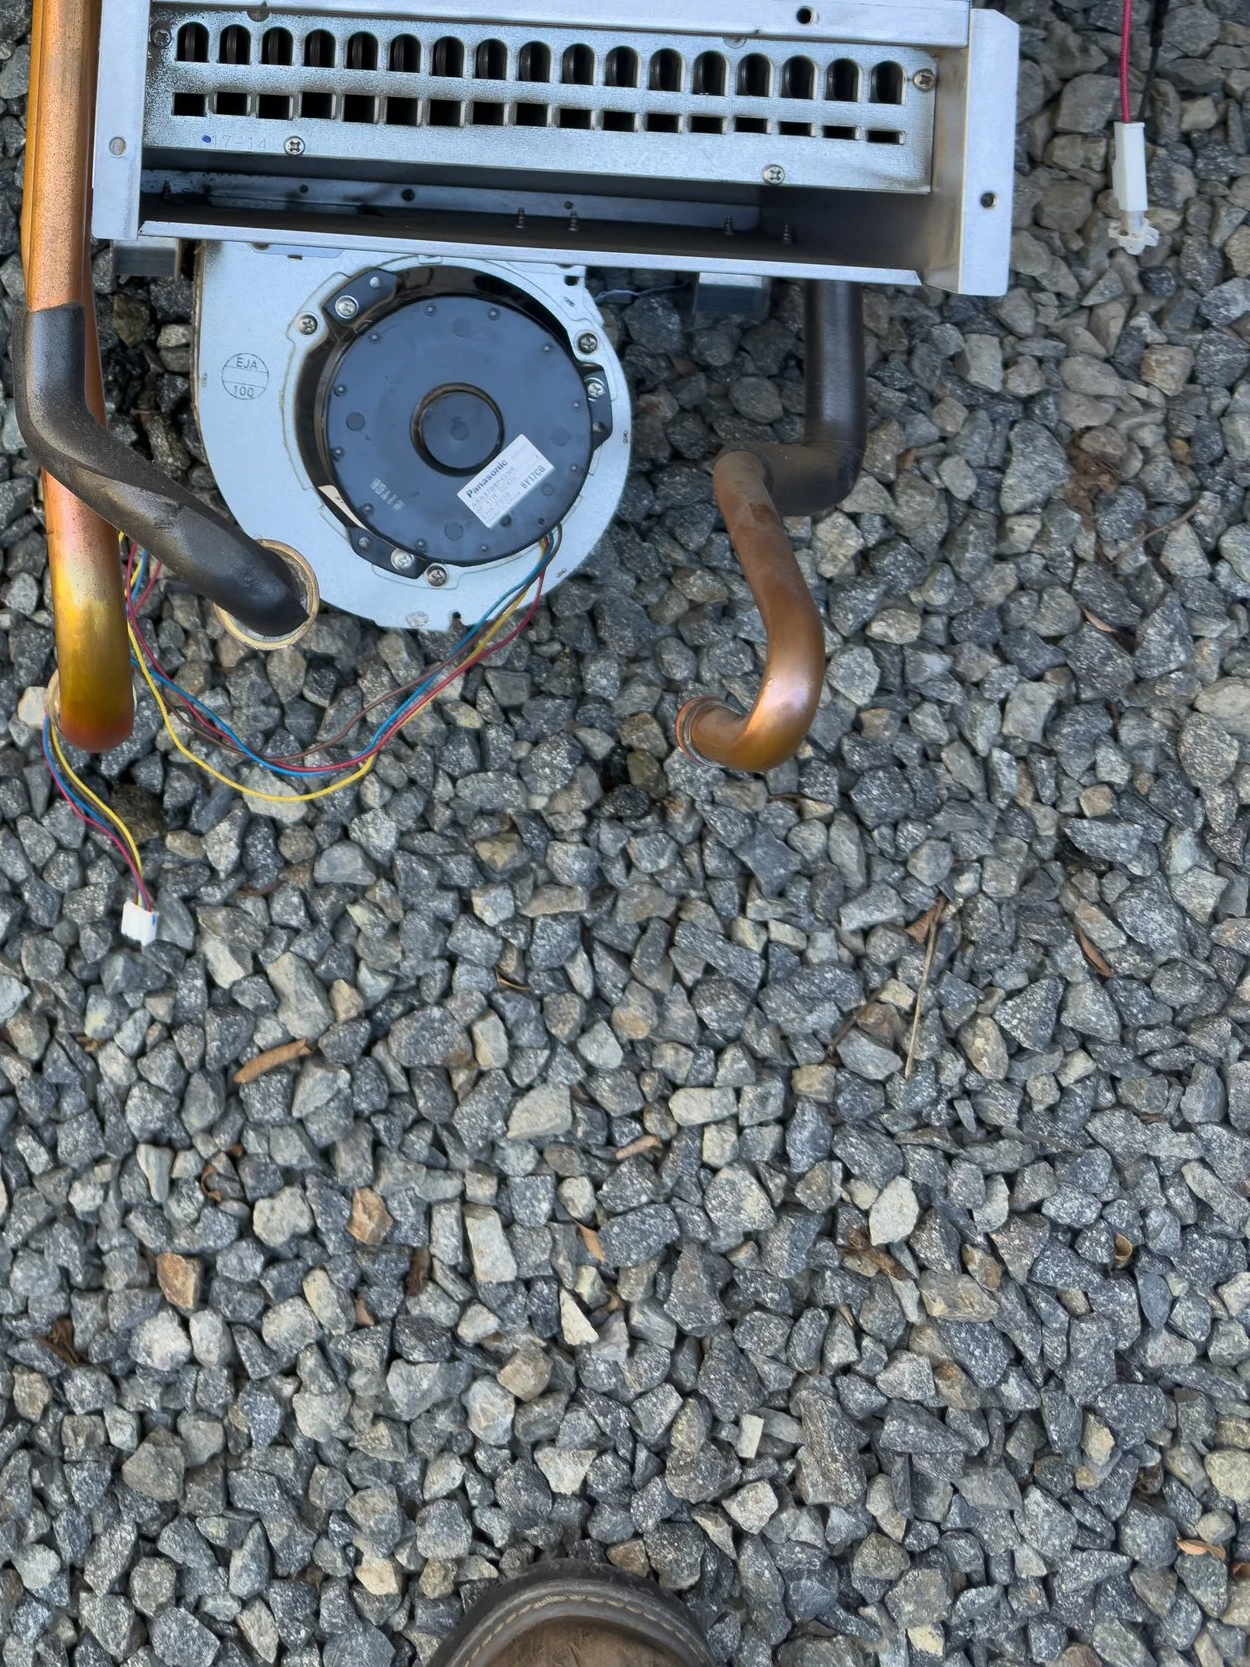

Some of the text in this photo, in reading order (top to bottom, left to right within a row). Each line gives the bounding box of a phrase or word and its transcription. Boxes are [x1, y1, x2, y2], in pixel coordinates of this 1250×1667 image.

[236, 357, 258, 370] EJA
[233, 385, 255, 398] 100
[464, 457, 508, 498] Panasonic
